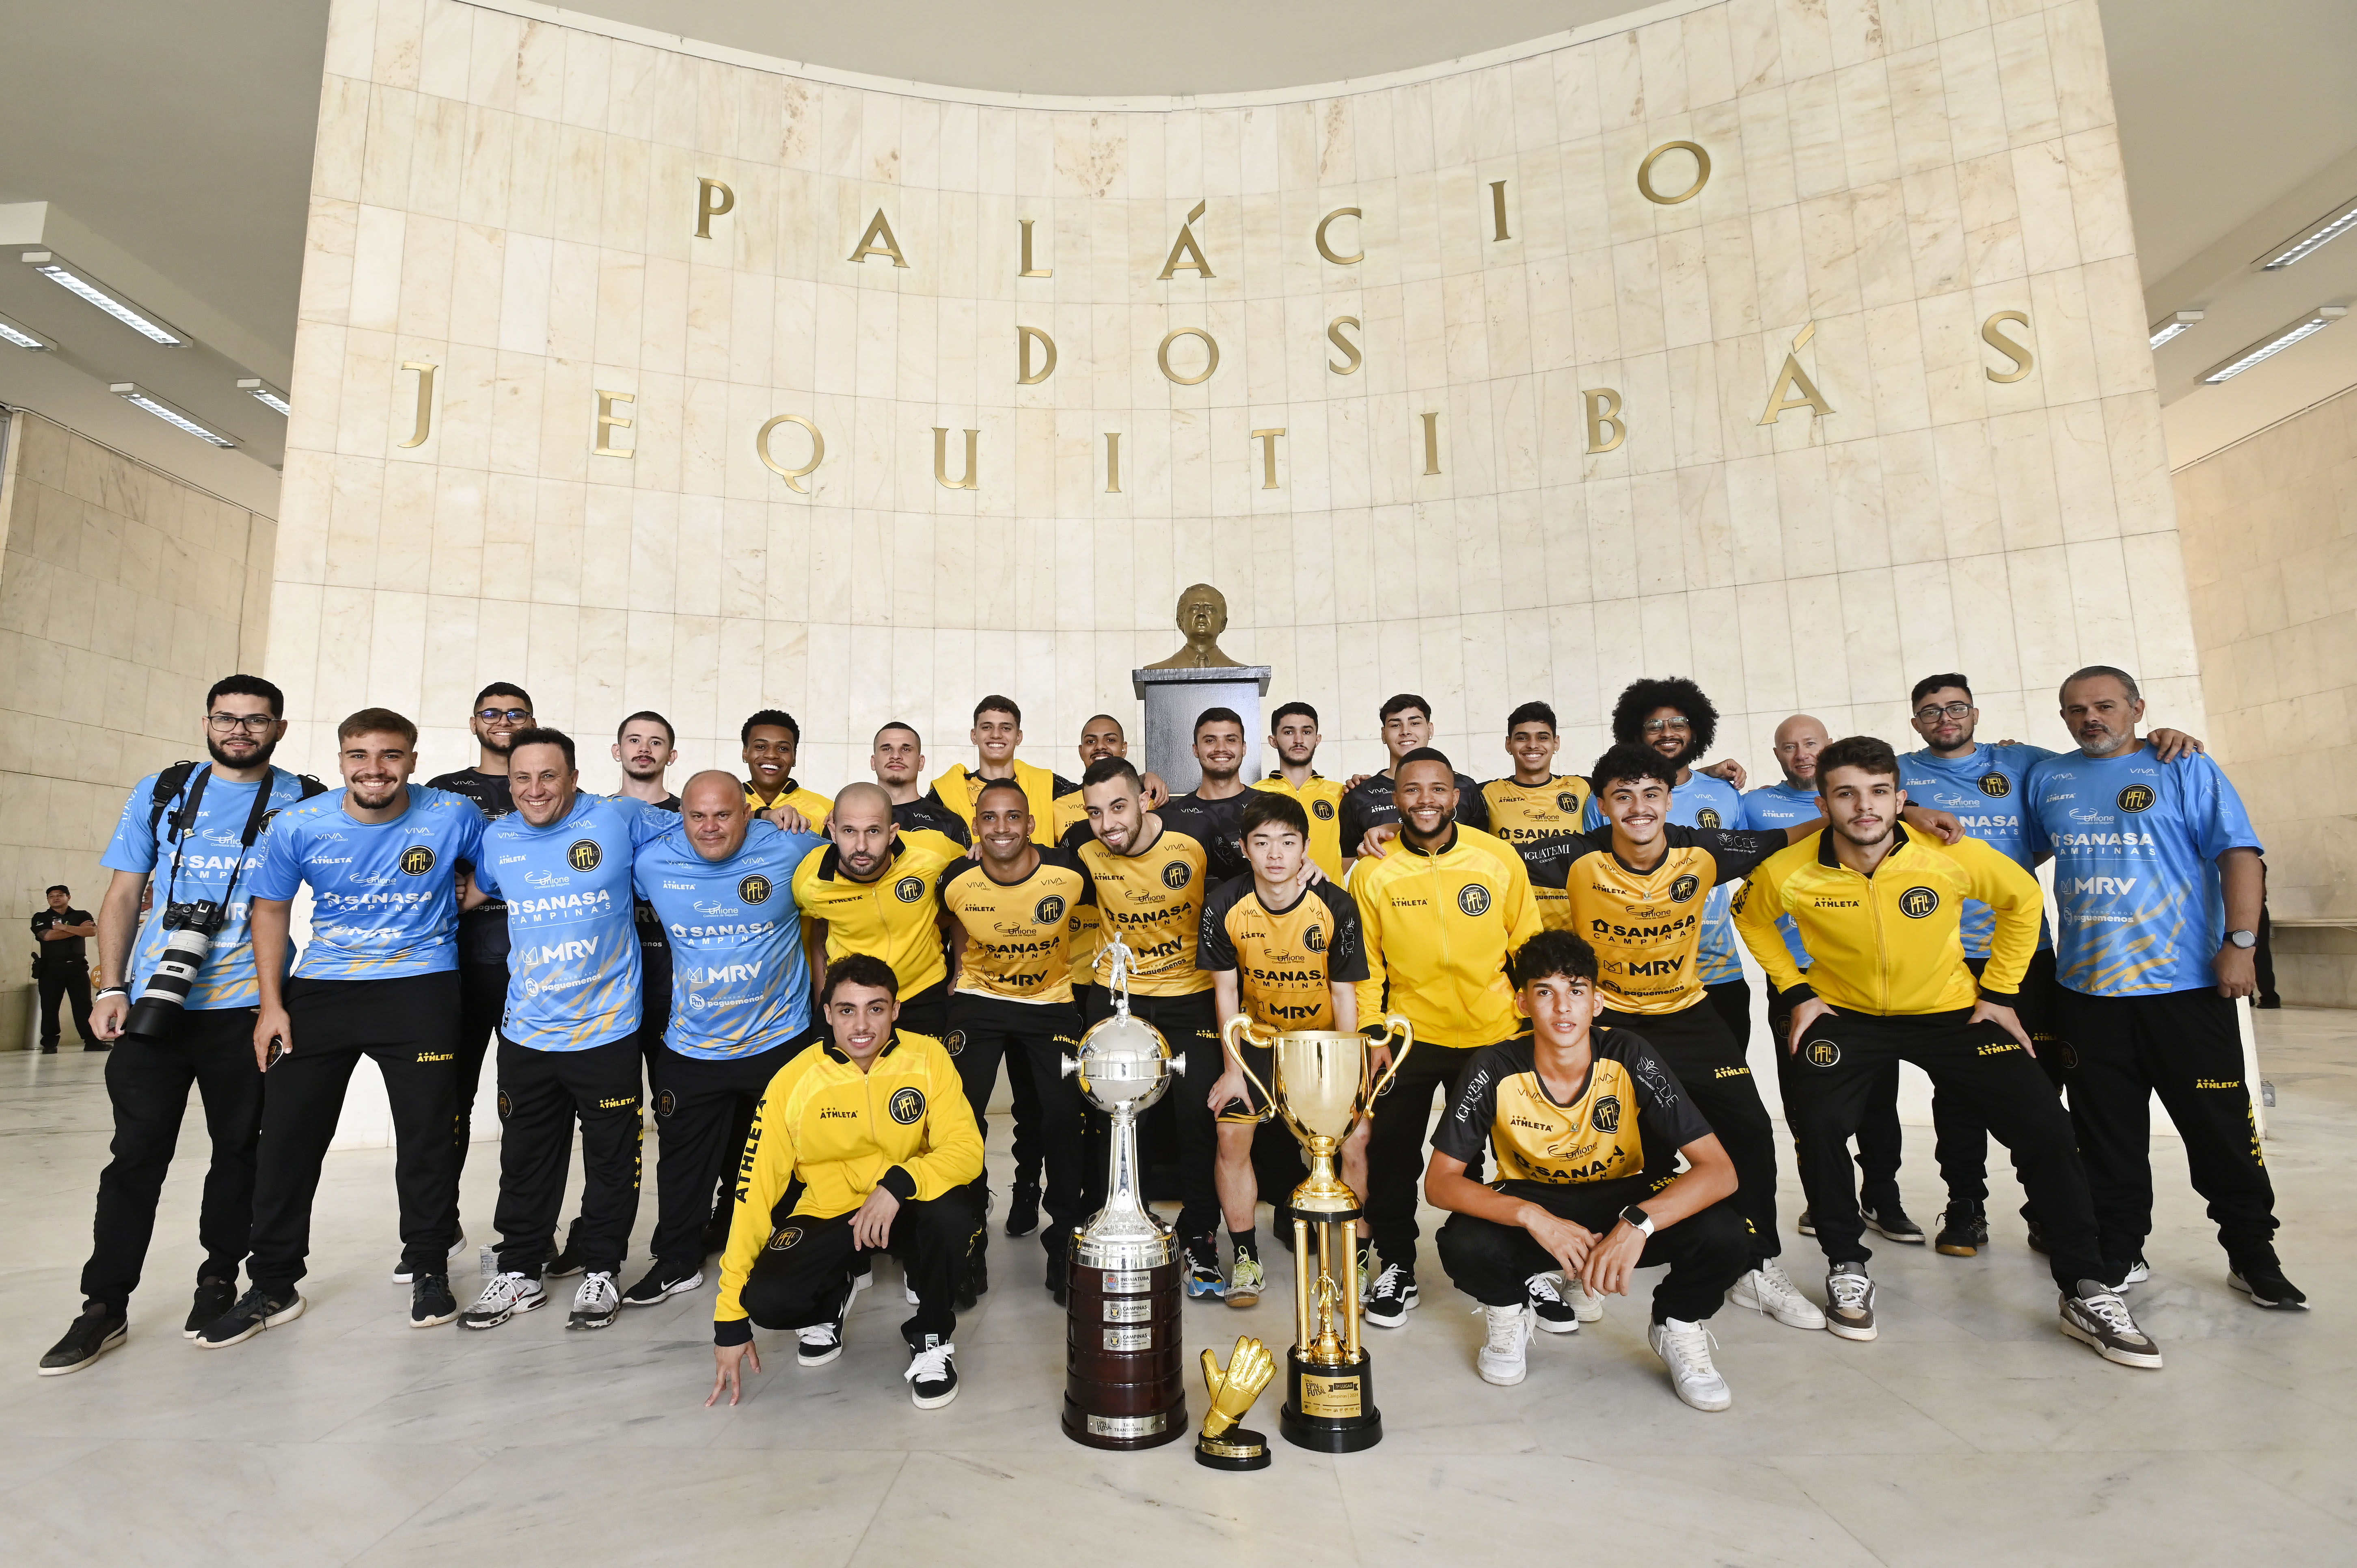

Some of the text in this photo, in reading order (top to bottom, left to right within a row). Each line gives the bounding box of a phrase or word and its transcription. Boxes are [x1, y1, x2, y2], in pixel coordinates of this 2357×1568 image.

[695, 141, 1711, 279] PALÁCIO
[1017, 316, 1361, 385] DOS
[399, 311, 2033, 491] JEQUITIBÁS
[2046, 793, 2075, 803] ATHLETA
[2125, 792, 2144, 808] PFC
[568, 820, 592, 828] VIVA
[2063, 833, 2155, 845] SANASA
[499, 855, 526, 865] ATHLETA
[576, 848, 594, 866] PFC
[1524, 844, 1570, 860] IGUATEMI
[408, 854, 425, 871] PFC
[742, 857, 764, 865] VIVA
[1670, 858, 1693, 869] VIVA
[540, 876, 569, 886] Unione
[1169, 869, 1185, 886] PFC
[2075, 877, 2137, 895] MRV
[747, 882, 763, 899] PFC
[903, 884, 917, 899] PFC
[1592, 885, 1625, 895] ATHLETA
[1677, 882, 1693, 899] PFC
[522, 889, 610, 913] SANASA
[828, 895, 861, 904] ATHLETA
[1466, 891, 1482, 911] PFC
[1910, 895, 1929, 915] PFC
[512, 902, 611, 924] CAMPINAS
[1043, 903, 1058, 921] PFC
[1118, 902, 1191, 923] SANASA
[1641, 909, 1671, 918] Unione
[2074, 914, 2134, 923] paguemenos
[690, 921, 775, 937] SANASA
[1613, 914, 1696, 938] SANASA
[1594, 925, 1696, 945] CAMPINAS
[542, 936, 599, 964] MRV
[986, 936, 1060, 953] SANASA
[1137, 935, 1183, 958] MRV
[708, 960, 763, 984] MRV
[1629, 955, 1685, 976] MRV
[541, 973, 602, 992] paguemenos
[998, 969, 1048, 986] MRV
[1624, 985, 1685, 997] paguemenos
[708, 994, 764, 1008] paguemenos
[1269, 1003, 1322, 1019] MRV
[417, 1054, 453, 1062] ATHLETA
[1814, 1045, 1832, 1063] PFC
[1593, 1072, 1614, 1087] VIVA
[1455, 1069, 1489, 1124] IGUATEMI
[1517, 1088, 1543, 1100] VIVA
[1655, 1075, 1679, 1108] CDE
[600, 1097, 635, 1109] ATHLETA
[898, 1098, 917, 1119] PFC
[820, 1111, 857, 1119] ATHLETA
[1510, 1118, 1551, 1132] ATHLETA
[735, 1098, 767, 1203] ATHLETA
[1566, 1141, 1597, 1158] Unione
[1307, 1387, 1326, 1397] FUTSAL
